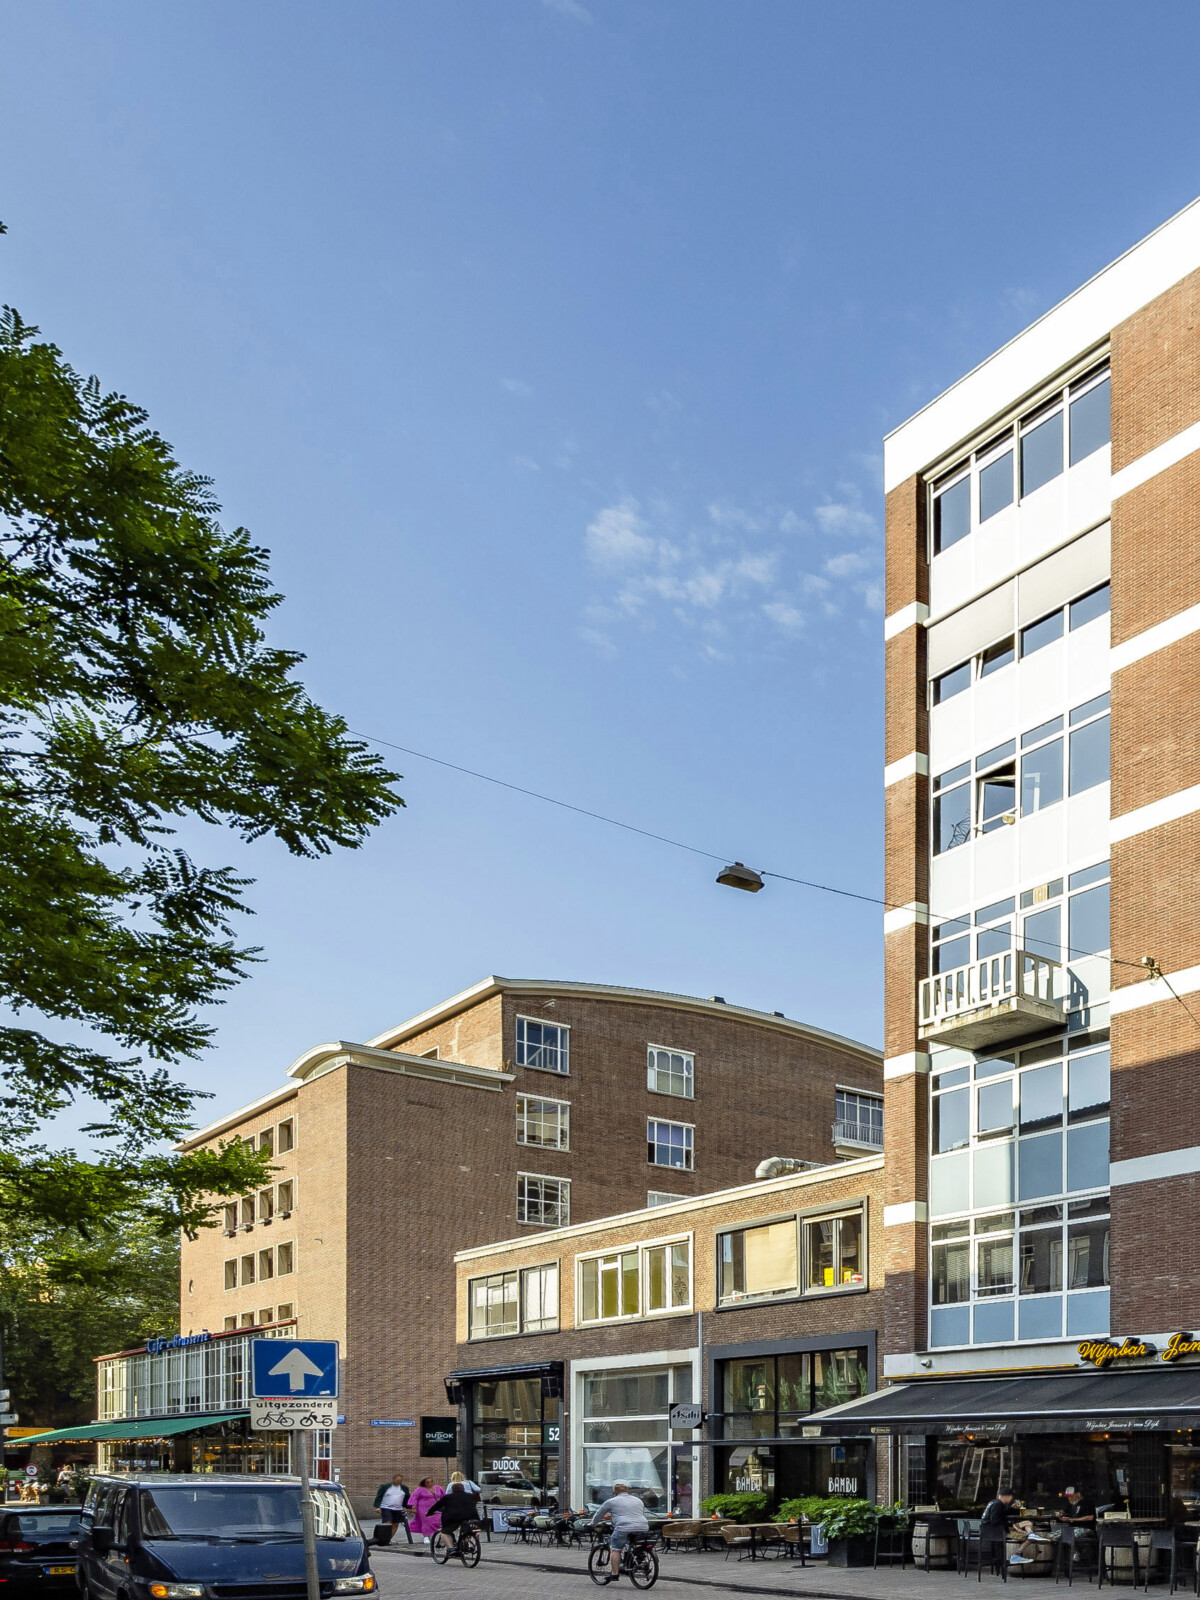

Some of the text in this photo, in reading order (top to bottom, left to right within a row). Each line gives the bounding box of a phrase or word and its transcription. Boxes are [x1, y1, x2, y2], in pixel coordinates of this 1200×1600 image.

[1077, 1337, 1147, 1367] Wijnbar
[256, 1401, 333, 1409] uitgezonderd
[671, 1410, 701, 1419] Asahi
[548, 1427, 560, 1441] 52
[492, 1459, 520, 1471] DUDOK
[735, 1477, 761, 1492] BAMBU
[828, 1477, 858, 1493] BAMBU
